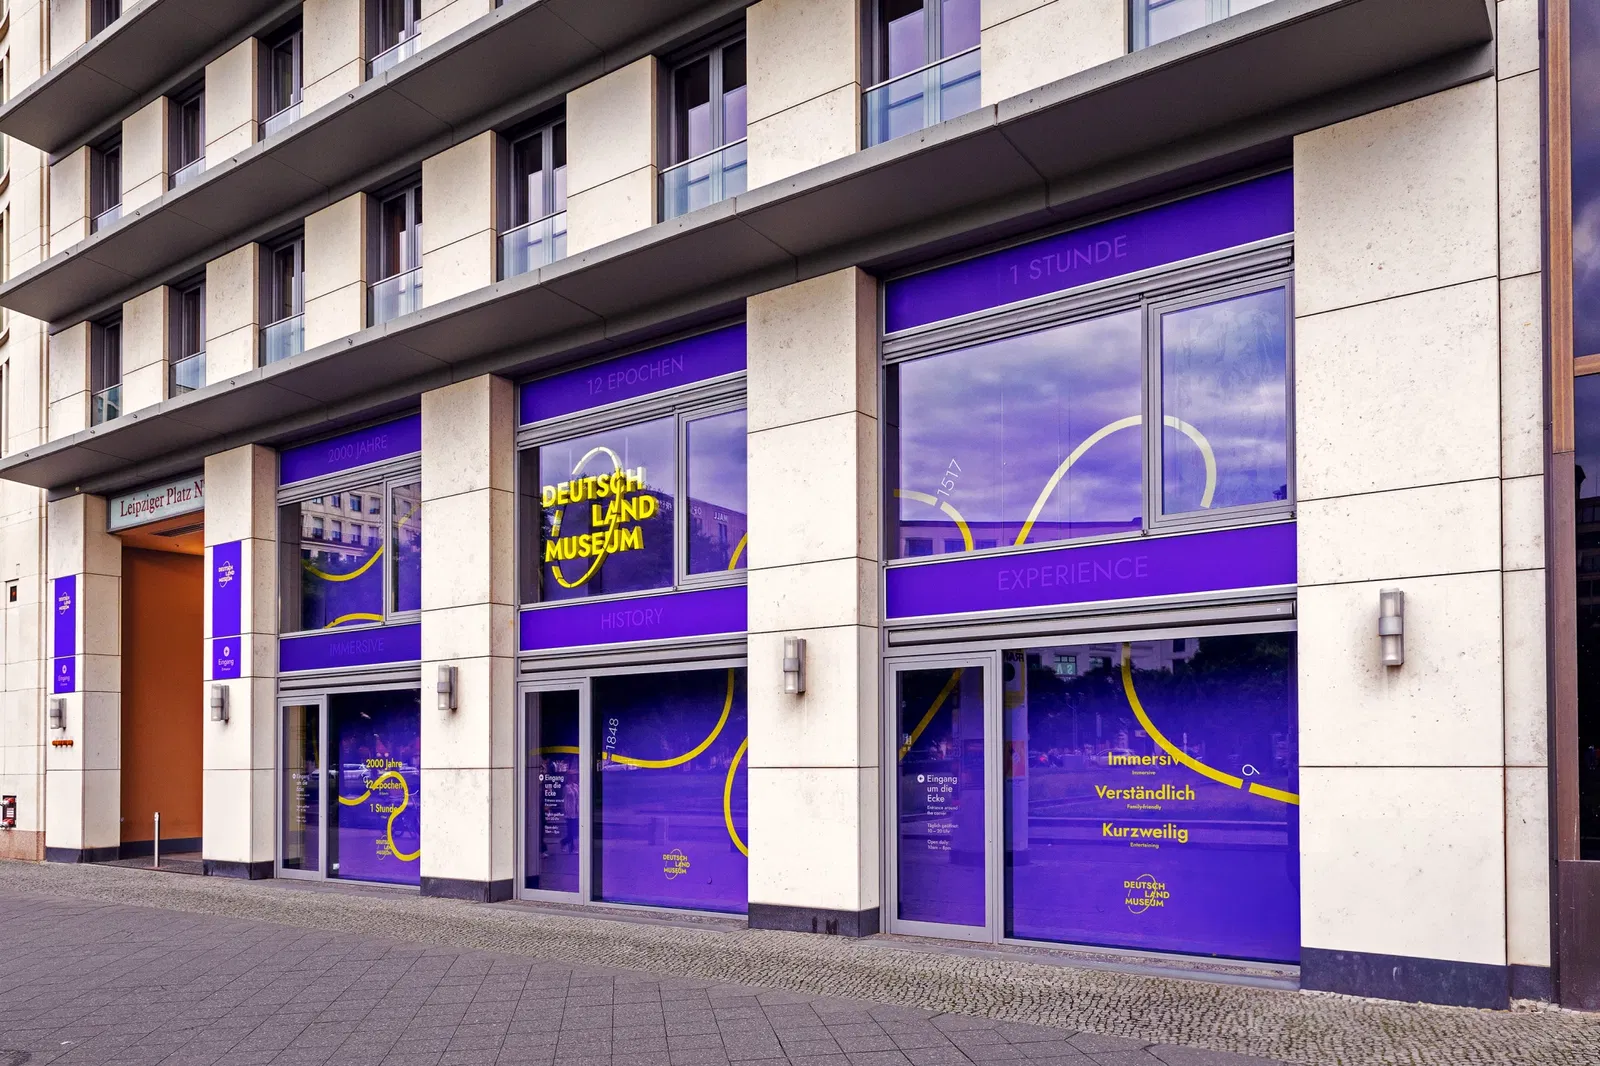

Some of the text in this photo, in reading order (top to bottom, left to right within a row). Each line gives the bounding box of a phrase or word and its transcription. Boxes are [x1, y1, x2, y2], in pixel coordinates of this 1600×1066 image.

[1010, 234, 1127, 285] 1 STUNDE
[586, 354, 684, 396] 12 EPOCHEN
[328, 434, 388, 464] 2000 JAHRE
[936, 458, 962, 497] 1517
[542, 466, 647, 508] DEUTSCH
[120, 493, 165, 518] Leipziger
[166, 486, 191, 506] Platz
[592, 494, 660, 527] LAND
[545, 525, 645, 562] MUSEUM
[998, 555, 1149, 591] EXPERIENCE
[601, 607, 664, 630] HISTORY
[329, 637, 384, 657] IMMERSIVE
[218, 658, 234, 668] Eingang
[605, 717, 619, 750] 1848
[366, 758, 403, 770] 2000 Jahre
[375, 779, 403, 791] pochen
[545, 774, 564, 782] Eingang
[927, 775, 958, 785] Eingang
[941, 782, 953, 793] die
[1094, 784, 1196, 801] Verständlich
[927, 793, 945, 803] Ecke
[369, 804, 374, 812] 1
[1102, 822, 1189, 844] Kurzweilig
[662, 854, 688, 862] DEUTSCH
[674, 860, 691, 868] LAND
[663, 867, 688, 875] MUSEUM
[1123, 880, 1166, 891] DEUTSCH
[1144, 890, 1171, 899] LAND
[1125, 897, 1165, 907] MUSEUM
